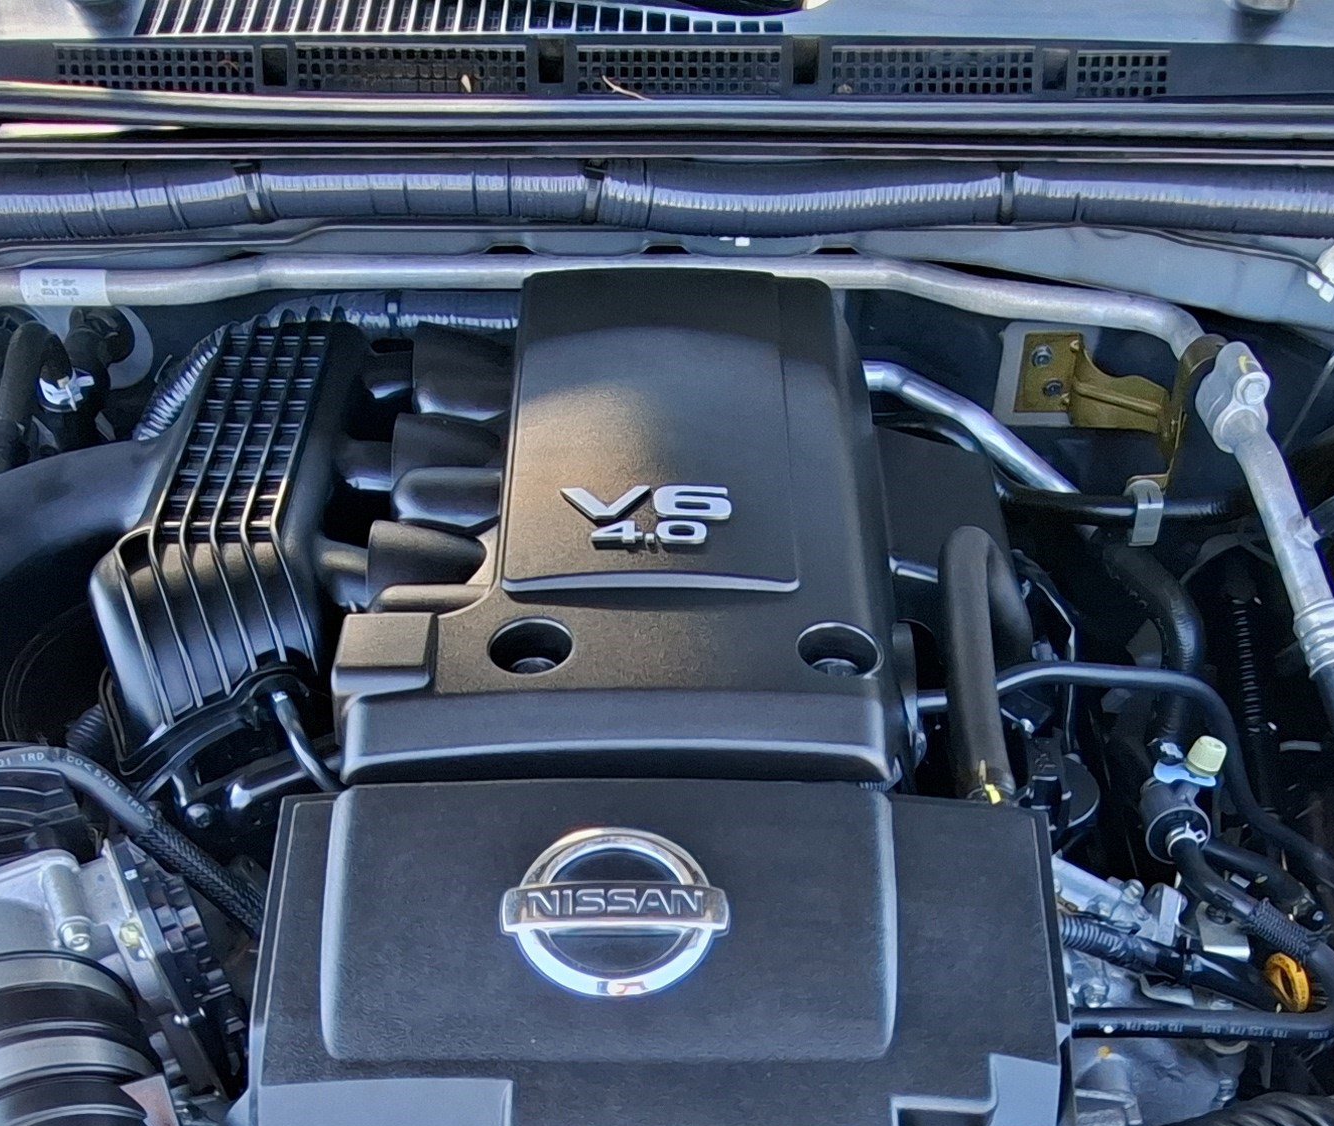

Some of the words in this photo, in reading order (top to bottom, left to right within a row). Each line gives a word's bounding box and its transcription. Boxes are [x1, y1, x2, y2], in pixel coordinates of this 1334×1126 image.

[560, 484, 732, 521] V6
[591, 520, 708, 549] 4.0
[526, 888, 704, 917] NISSAN
